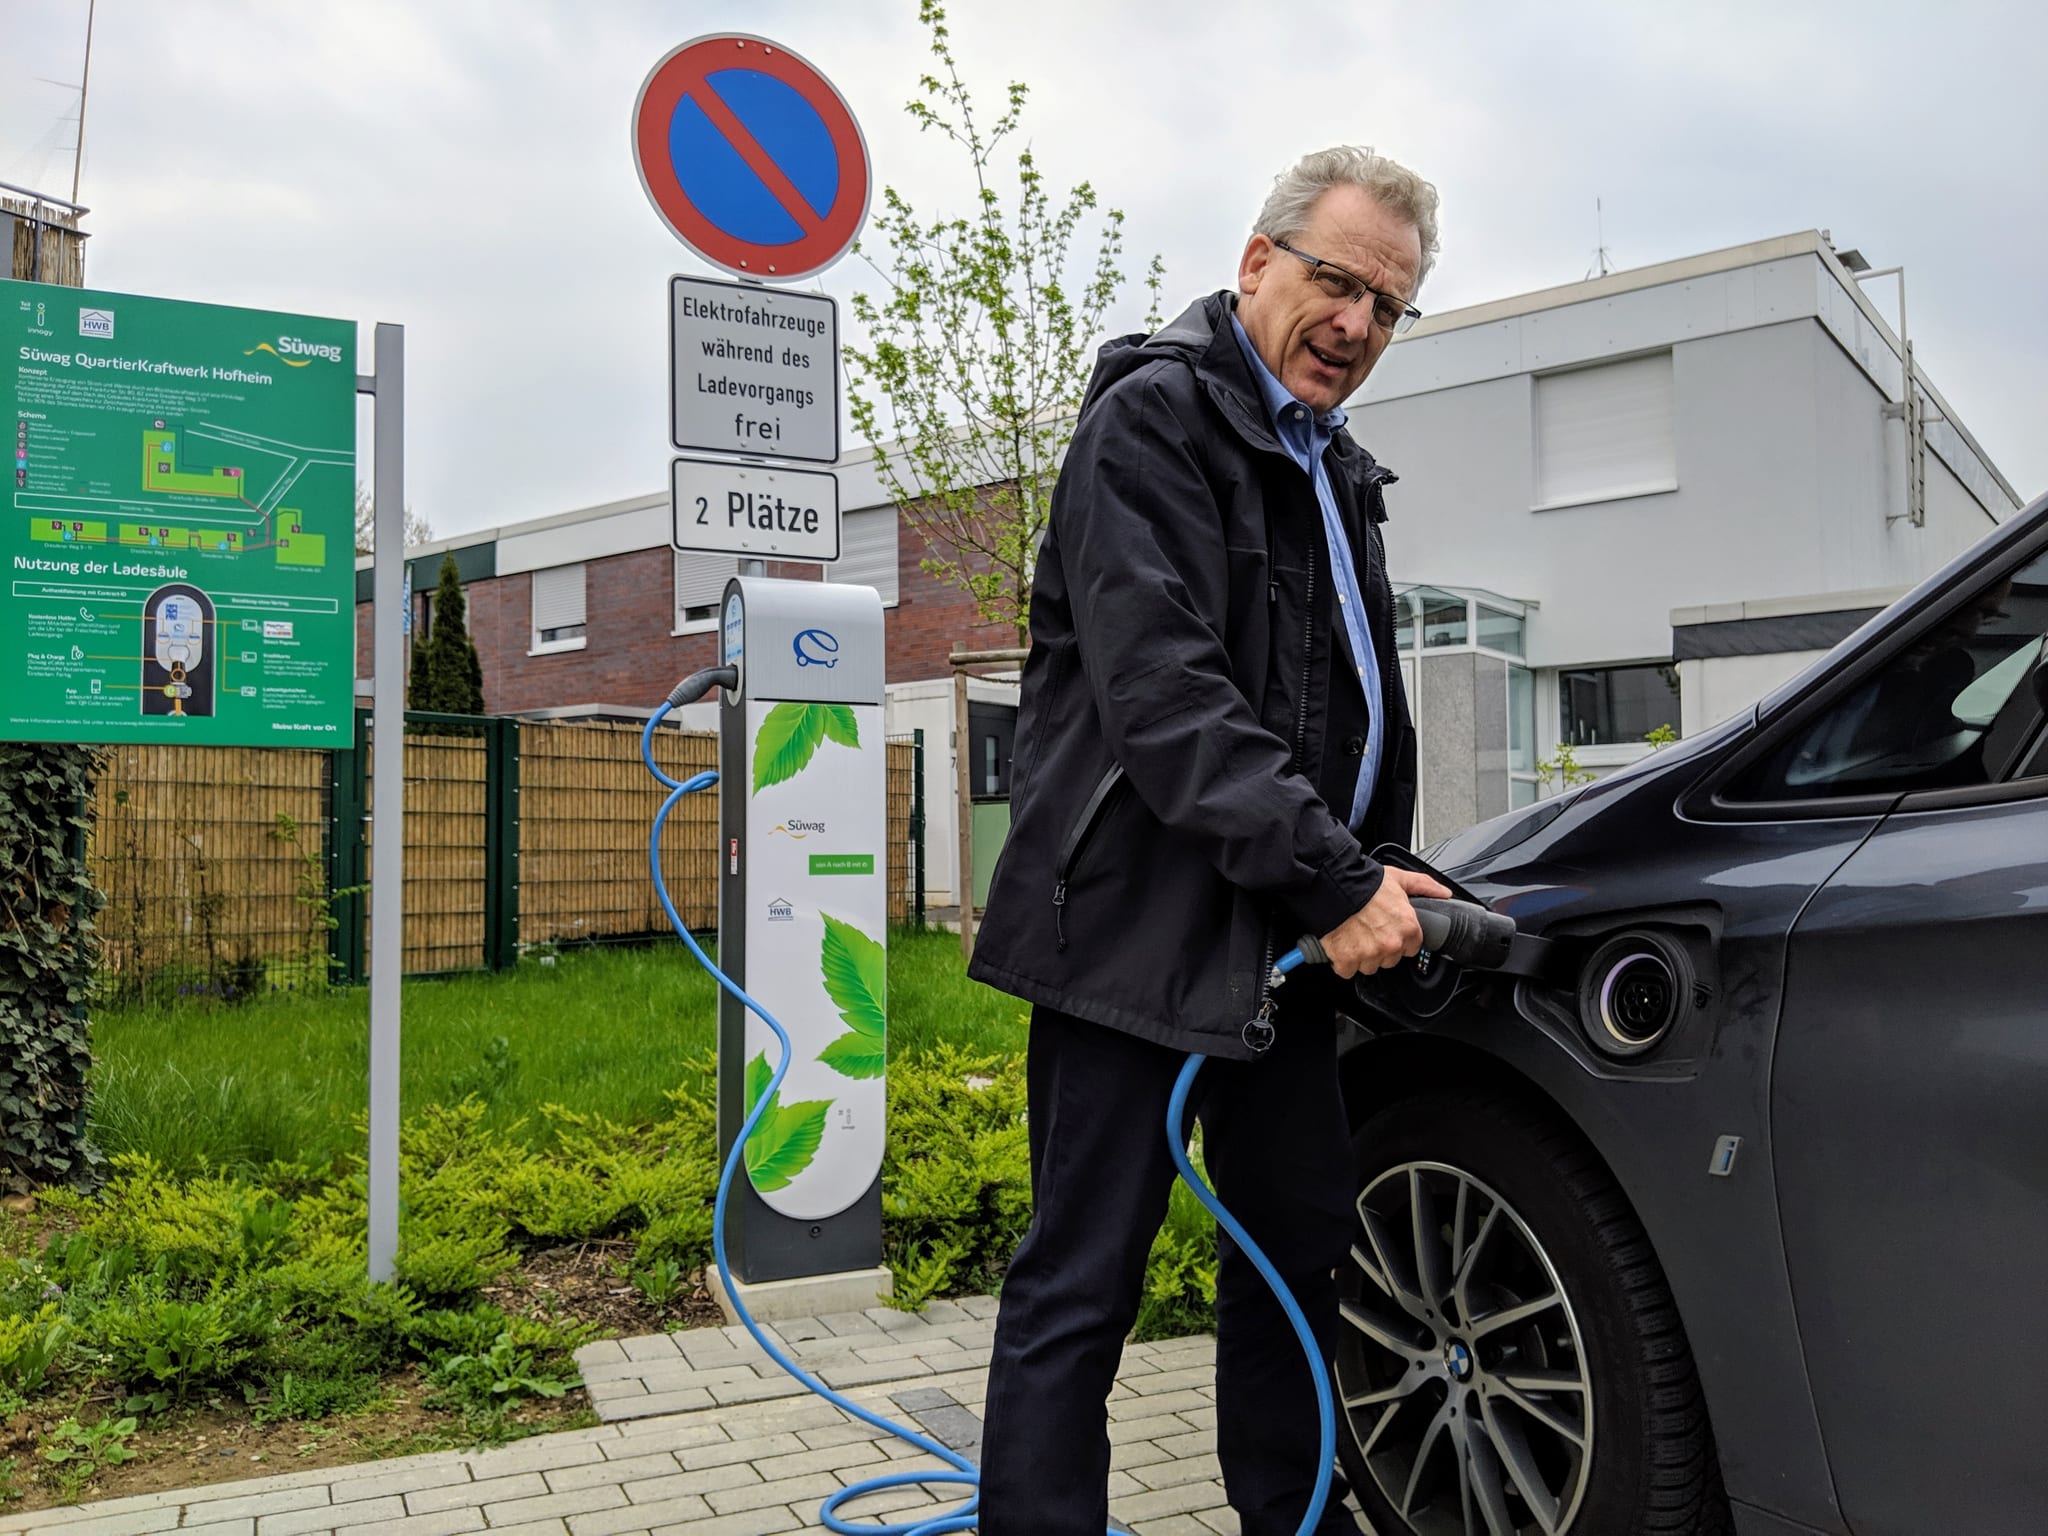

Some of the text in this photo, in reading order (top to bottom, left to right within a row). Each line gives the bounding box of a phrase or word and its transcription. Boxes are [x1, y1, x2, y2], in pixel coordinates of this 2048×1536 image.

[83, 320, 110, 331] HWB
[683, 297, 826, 338] Elektrofahrzeuge
[27, 327, 53, 337] innogy
[278, 336, 342, 362] Süwag
[702, 337, 810, 368] während des
[18, 366, 48, 376] Konzept
[19, 346, 273, 385] Süwag QuartierKraftwerk Hofheim
[698, 373, 814, 409] Ladevorgangs
[17, 410, 47, 420] Schema
[735, 413, 780, 440] frei
[696, 491, 818, 534] 2 Plätze
[14, 556, 188, 579] Nutzung der Ladesäule
[788, 820, 825, 833] Süwag
[770, 908, 791, 916] HWB
